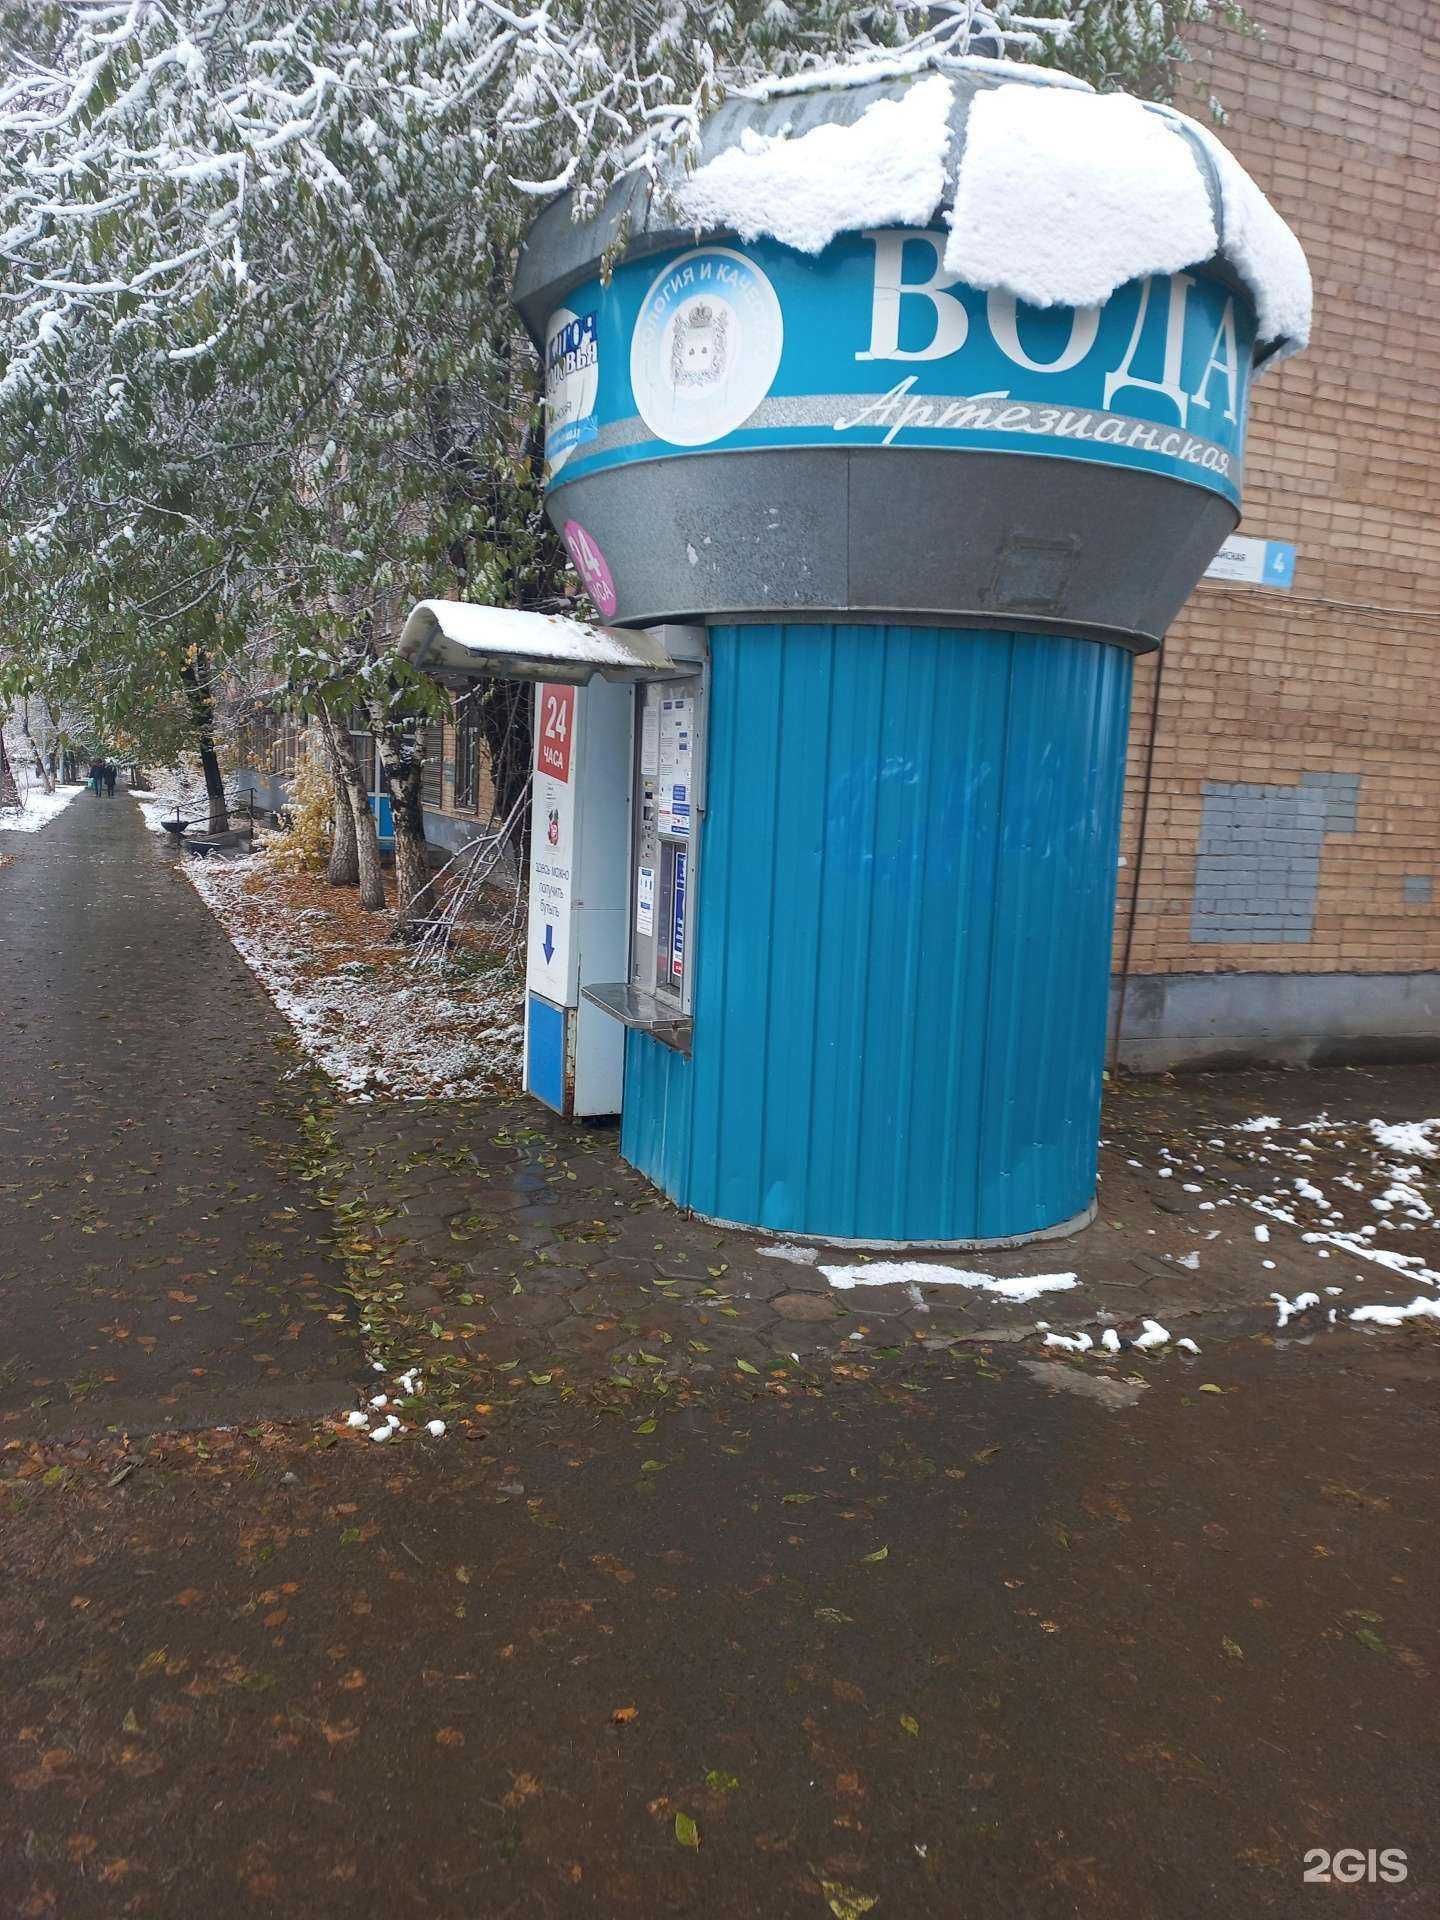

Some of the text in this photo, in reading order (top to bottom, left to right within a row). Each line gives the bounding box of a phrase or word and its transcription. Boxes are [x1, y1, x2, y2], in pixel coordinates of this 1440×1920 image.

[855, 229, 1238, 428] ВОДА
[833, 376, 1231, 478] Артезианская
[567, 529, 602, 581] 24
[1273, 552, 1285, 573] 4
[545, 696, 567, 742] 24
[543, 745, 564, 769] ЧАСА
